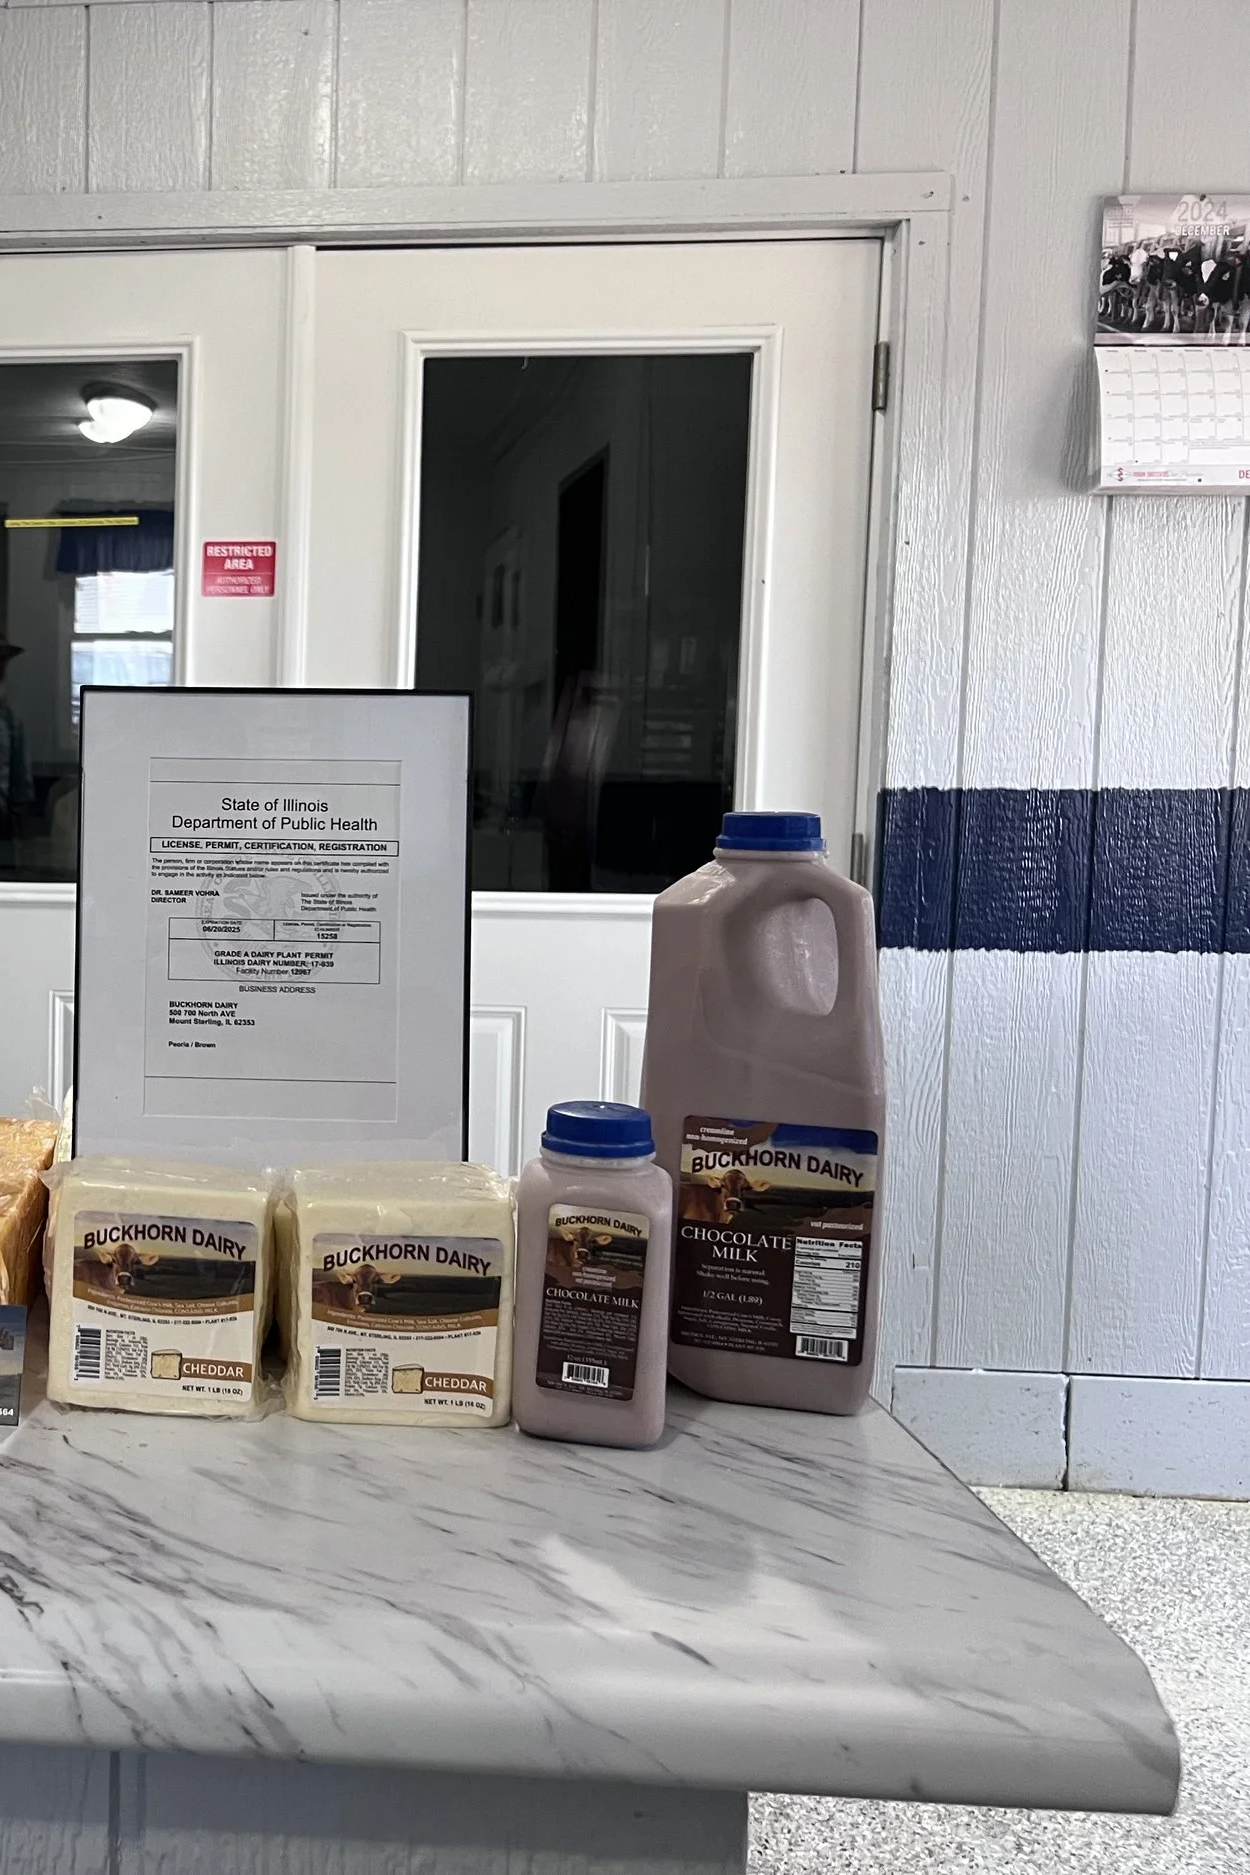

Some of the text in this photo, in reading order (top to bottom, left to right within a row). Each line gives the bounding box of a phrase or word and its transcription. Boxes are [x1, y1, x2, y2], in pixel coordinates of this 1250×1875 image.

[1177, 200, 1229, 221] 2024
[1174, 224, 1230, 236] DECEMBER
[206, 545, 272, 557] RESTRICTED
[223, 558, 255, 570] AREA
[221, 797, 329, 813] State of Illinois
[172, 815, 378, 832] Department of Public Health
[161, 841, 387, 852] LICENSE, PERMIT, CERTIFICATION, REGISTRATION
[236, 967, 259, 975] Facility
[238, 985, 278, 993] BUSINESS
[699, 1126, 735, 1136] creamline
[692, 1150, 864, 1188] BUCKHORN DAIRY
[555, 1215, 642, 1237] BUCKHORN DAIRY
[84, 1224, 247, 1260] BUCKHORN DAIRY
[681, 1225, 793, 1250] CHOCOLATE
[796, 1238, 835, 1248] Nutrition
[323, 1243, 492, 1276] BUCKHORN DAIRY
[712, 1245, 758, 1262] MILK
[546, 1287, 639, 1309] CHOCOLATE MILK
[702, 1290, 736, 1301] 1/2 GAL
[182, 1362, 244, 1378] CHEDDAR
[195, 1385, 206, 1393] WT.
[232, 1388, 244, 1396] OZ)
[424, 1376, 487, 1393] CHEDDAR
[475, 1402, 486, 1410] OZ)
